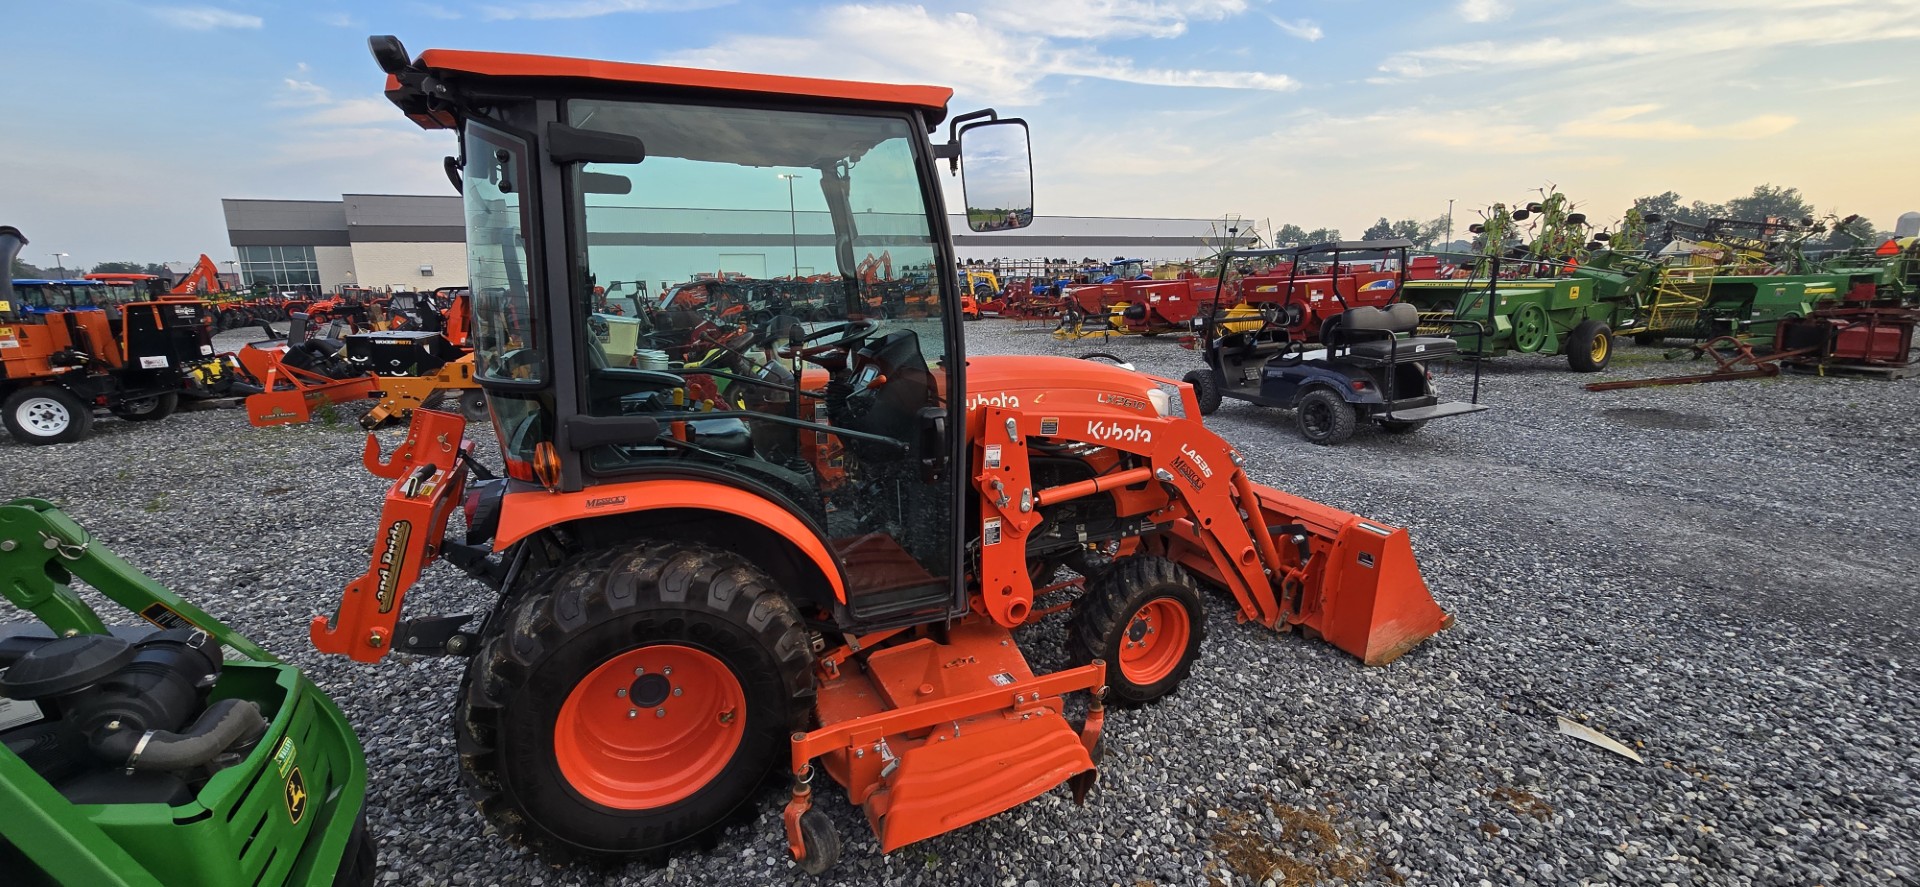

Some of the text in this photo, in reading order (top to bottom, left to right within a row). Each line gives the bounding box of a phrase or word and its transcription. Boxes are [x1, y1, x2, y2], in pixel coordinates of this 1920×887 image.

[966, 392, 1019, 411] ubota
[1097, 392, 1146, 411] LX2610
[1087, 420, 1152, 443] Kubota
[1180, 443, 1213, 478] LA535
[381, 521, 401, 564] Pride
